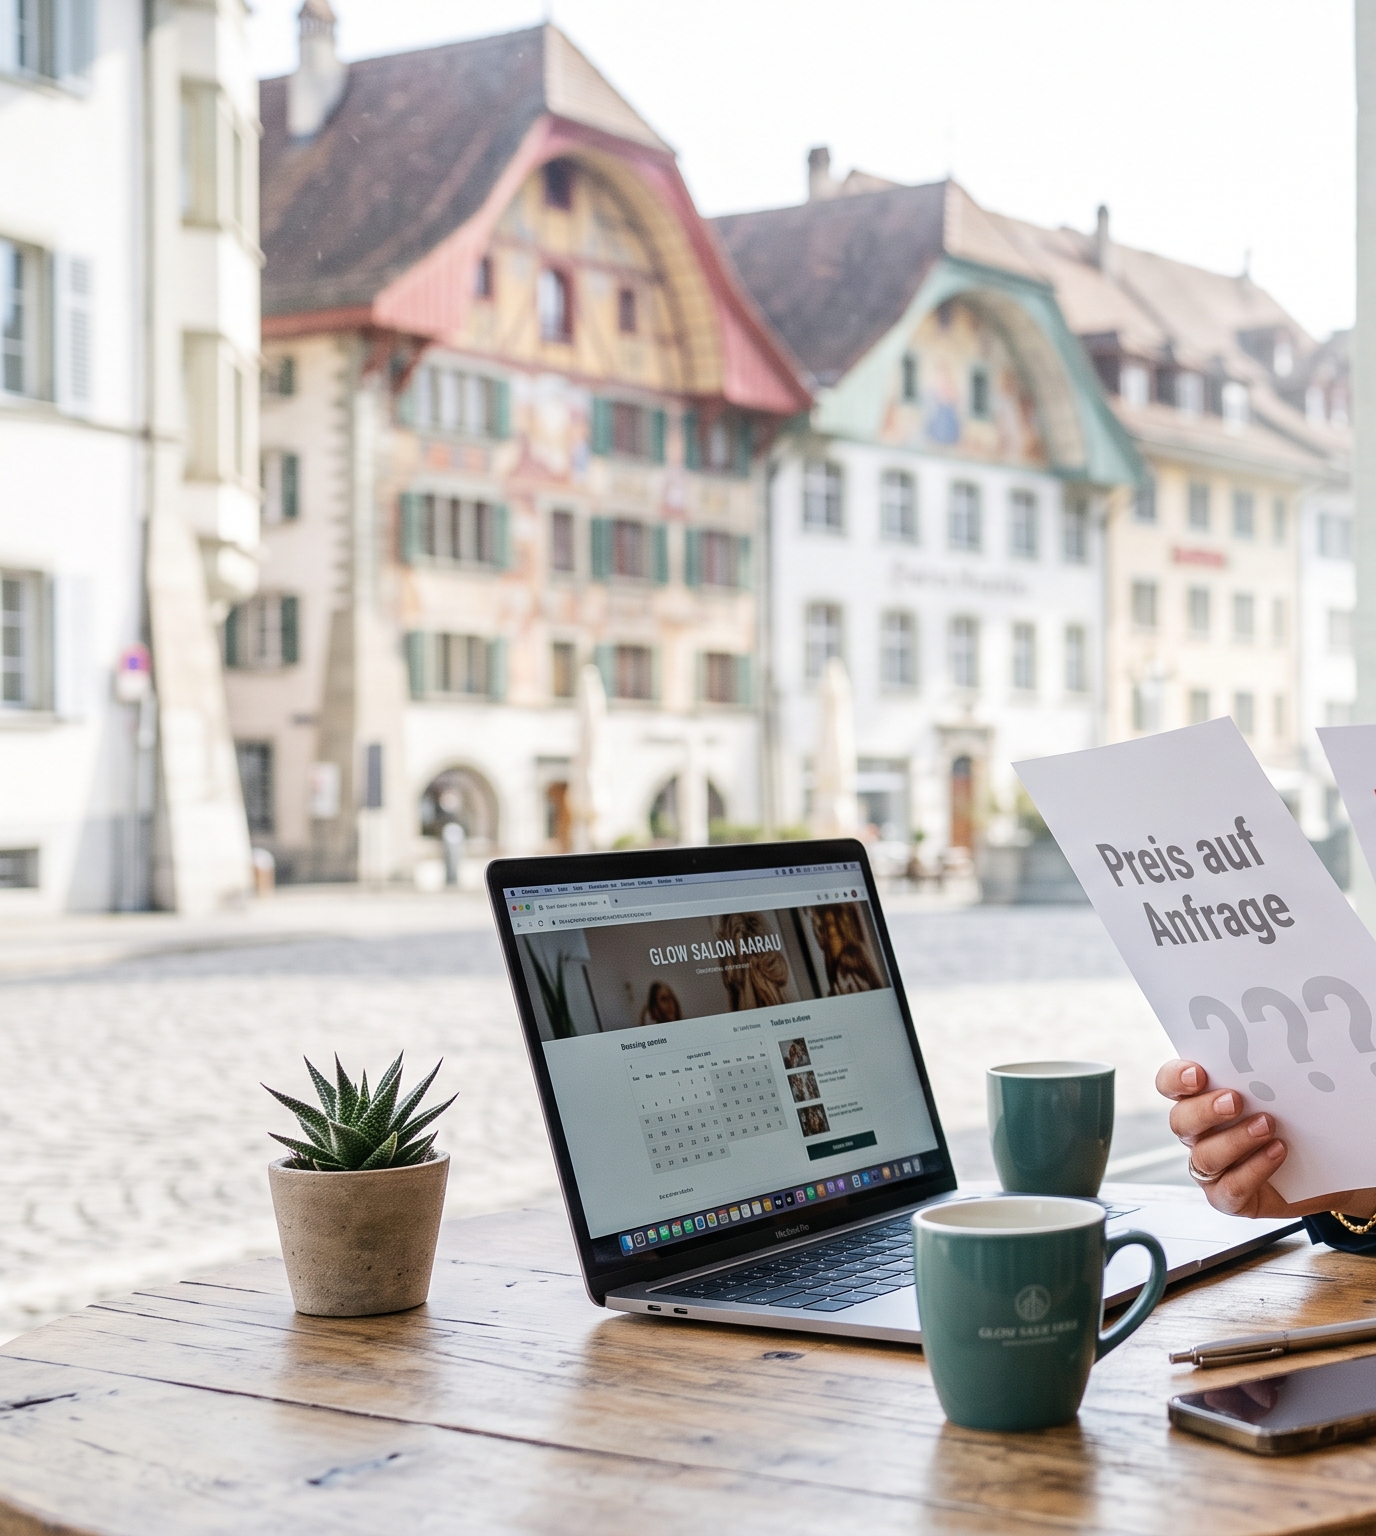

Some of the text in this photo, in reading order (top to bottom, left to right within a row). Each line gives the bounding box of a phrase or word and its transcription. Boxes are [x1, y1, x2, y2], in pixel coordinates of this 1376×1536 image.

[1096, 816, 1264, 886] Preis auf
[1143, 894, 1295, 946] Anfrage
[650, 934, 781, 965] GLOW SALON AARAU
